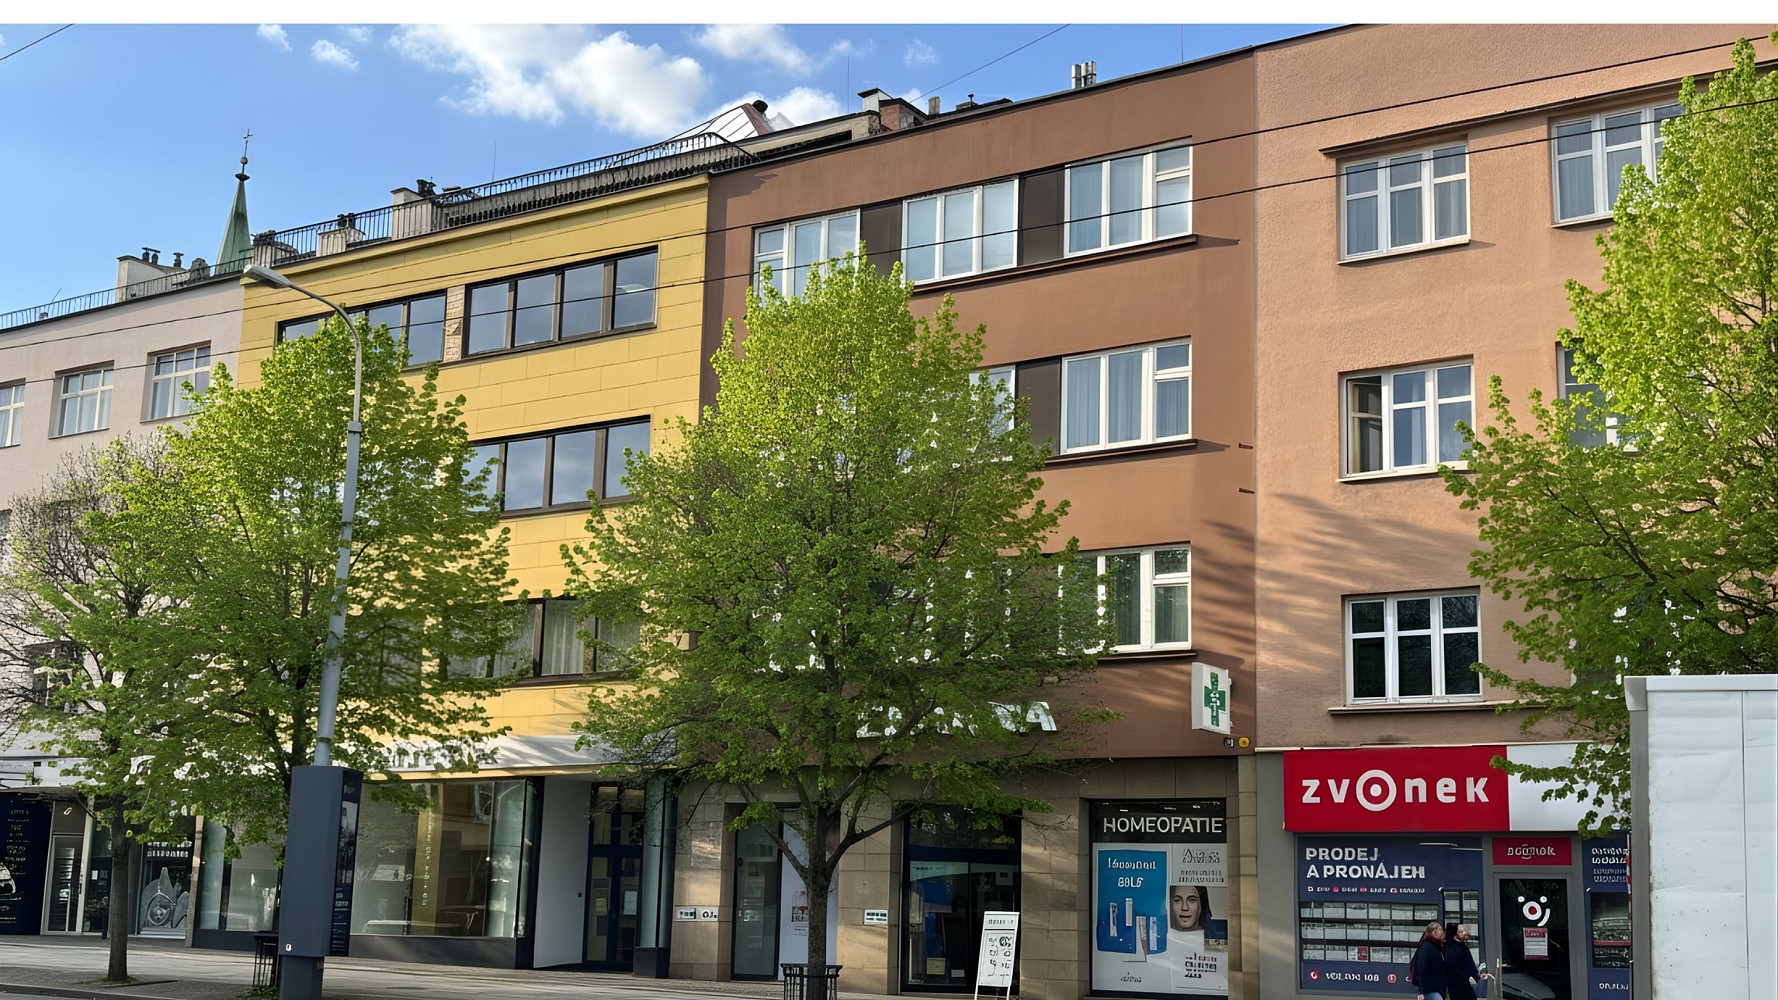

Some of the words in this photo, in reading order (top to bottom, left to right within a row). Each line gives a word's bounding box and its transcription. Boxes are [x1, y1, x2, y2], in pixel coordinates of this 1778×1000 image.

[1103, 816, 1224, 834] HOMEOPATIE
[1306, 847, 1379, 862] PRODEJ
[1306, 864, 1320, 879] A
